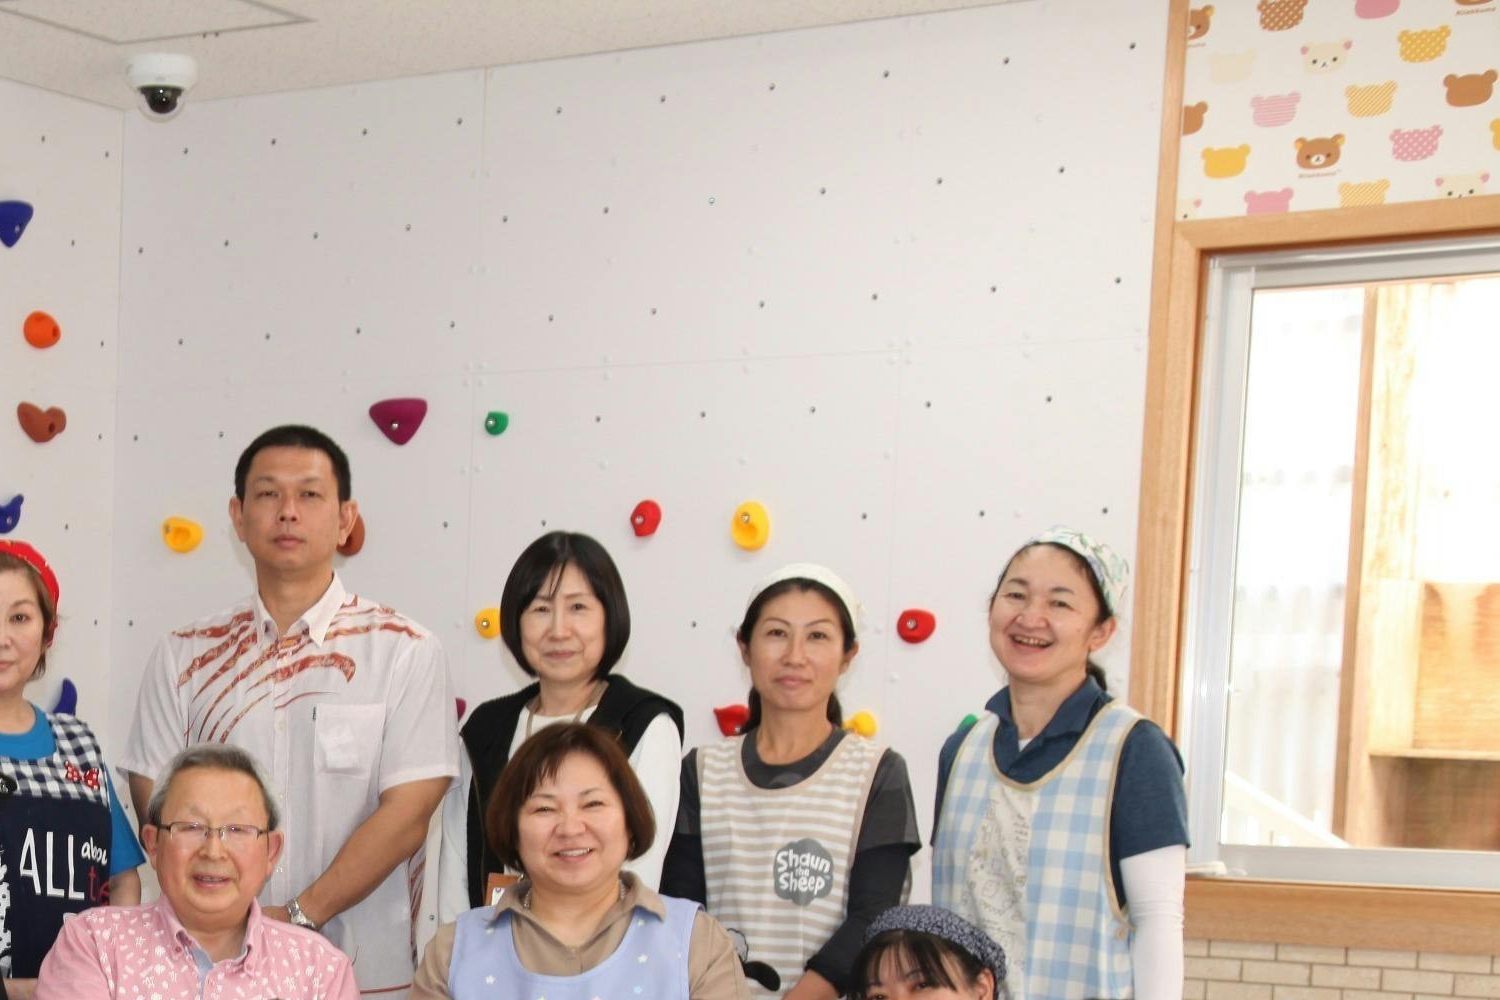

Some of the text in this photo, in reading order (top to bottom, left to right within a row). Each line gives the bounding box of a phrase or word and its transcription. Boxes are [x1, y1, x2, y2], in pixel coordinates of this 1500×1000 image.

[19, 827, 85, 901] ALL
[777, 848, 831, 874] Shaun
[795, 866, 810, 877] the
[779, 871, 825, 896] Sheep
